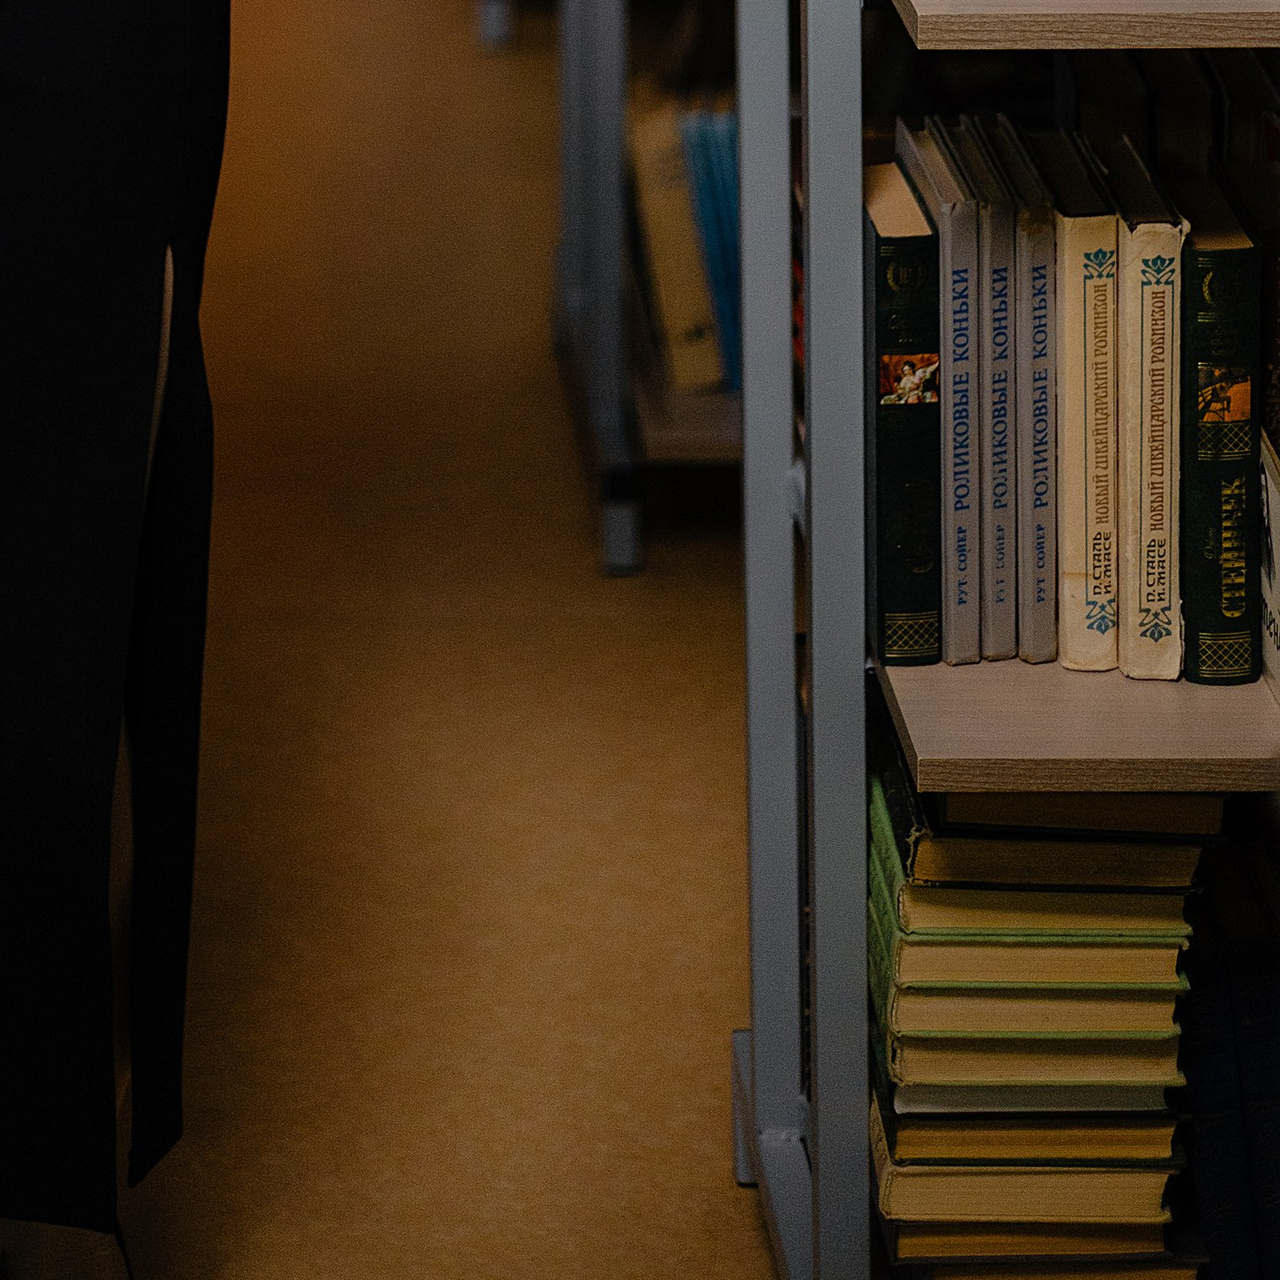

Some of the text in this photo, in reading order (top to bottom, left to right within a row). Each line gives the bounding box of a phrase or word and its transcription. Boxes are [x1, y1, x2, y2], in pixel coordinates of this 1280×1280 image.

[951, 267, 970, 511] РОЛИКОВЫЕ КОНЬКИ
[991, 266, 1008, 509] РОЛИКОВЫЕ КОНЬКИ
[1032, 264, 1049, 508] РОЛИКОВЫЕ КОНЬКИ
[1090, 282, 1111, 524] НОВЫЙ ШВЕЙЦАРСКИЙ РОБИНЗОН
[1146, 289, 1168, 531] НОВЫЙ ШВЕЙЦАРСКИЙ РОБИНЗОН
[956, 526, 968, 606] РУТ СОЙЕР
[1036, 577, 1046, 603] РУТ
[1092, 532, 1103, 581] СТАЛЬ
[1102, 531, 1113, 582] МАСЕ
[1146, 538, 1157, 588] СТАЛЬ
[1155, 538, 1167, 587] МАСЕ
